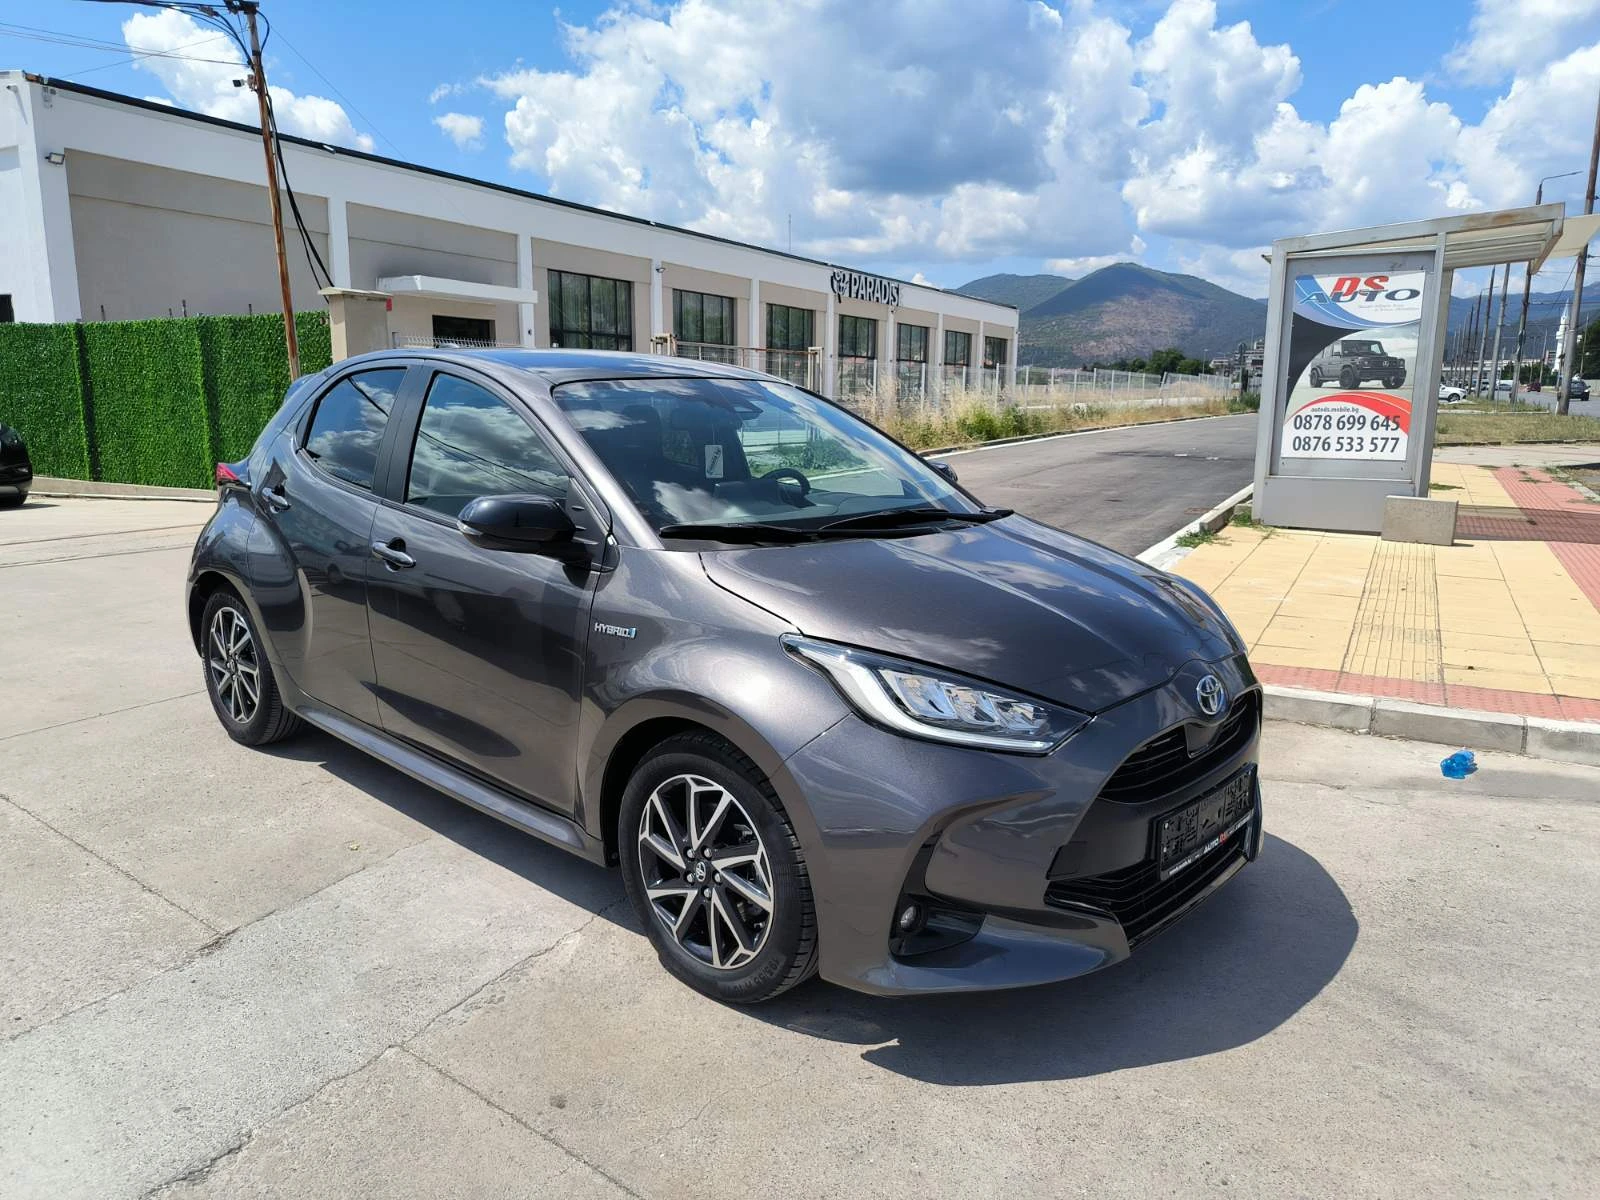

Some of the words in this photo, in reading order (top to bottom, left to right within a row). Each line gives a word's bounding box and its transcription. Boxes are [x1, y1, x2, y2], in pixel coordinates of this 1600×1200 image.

[849, 273, 899, 306] PARADIS
[1330, 275, 1389, 297] DS
[1299, 288, 1420, 303] AUTO
[1293, 414, 1332, 431] 0878
[1336, 414, 1366, 431] 699
[1370, 415, 1400, 431] 645
[1292, 436, 1331, 451] 0876
[1335, 436, 1364, 452] 533
[1369, 437, 1400, 453] 577
[594, 622, 629, 637] HYBRID
